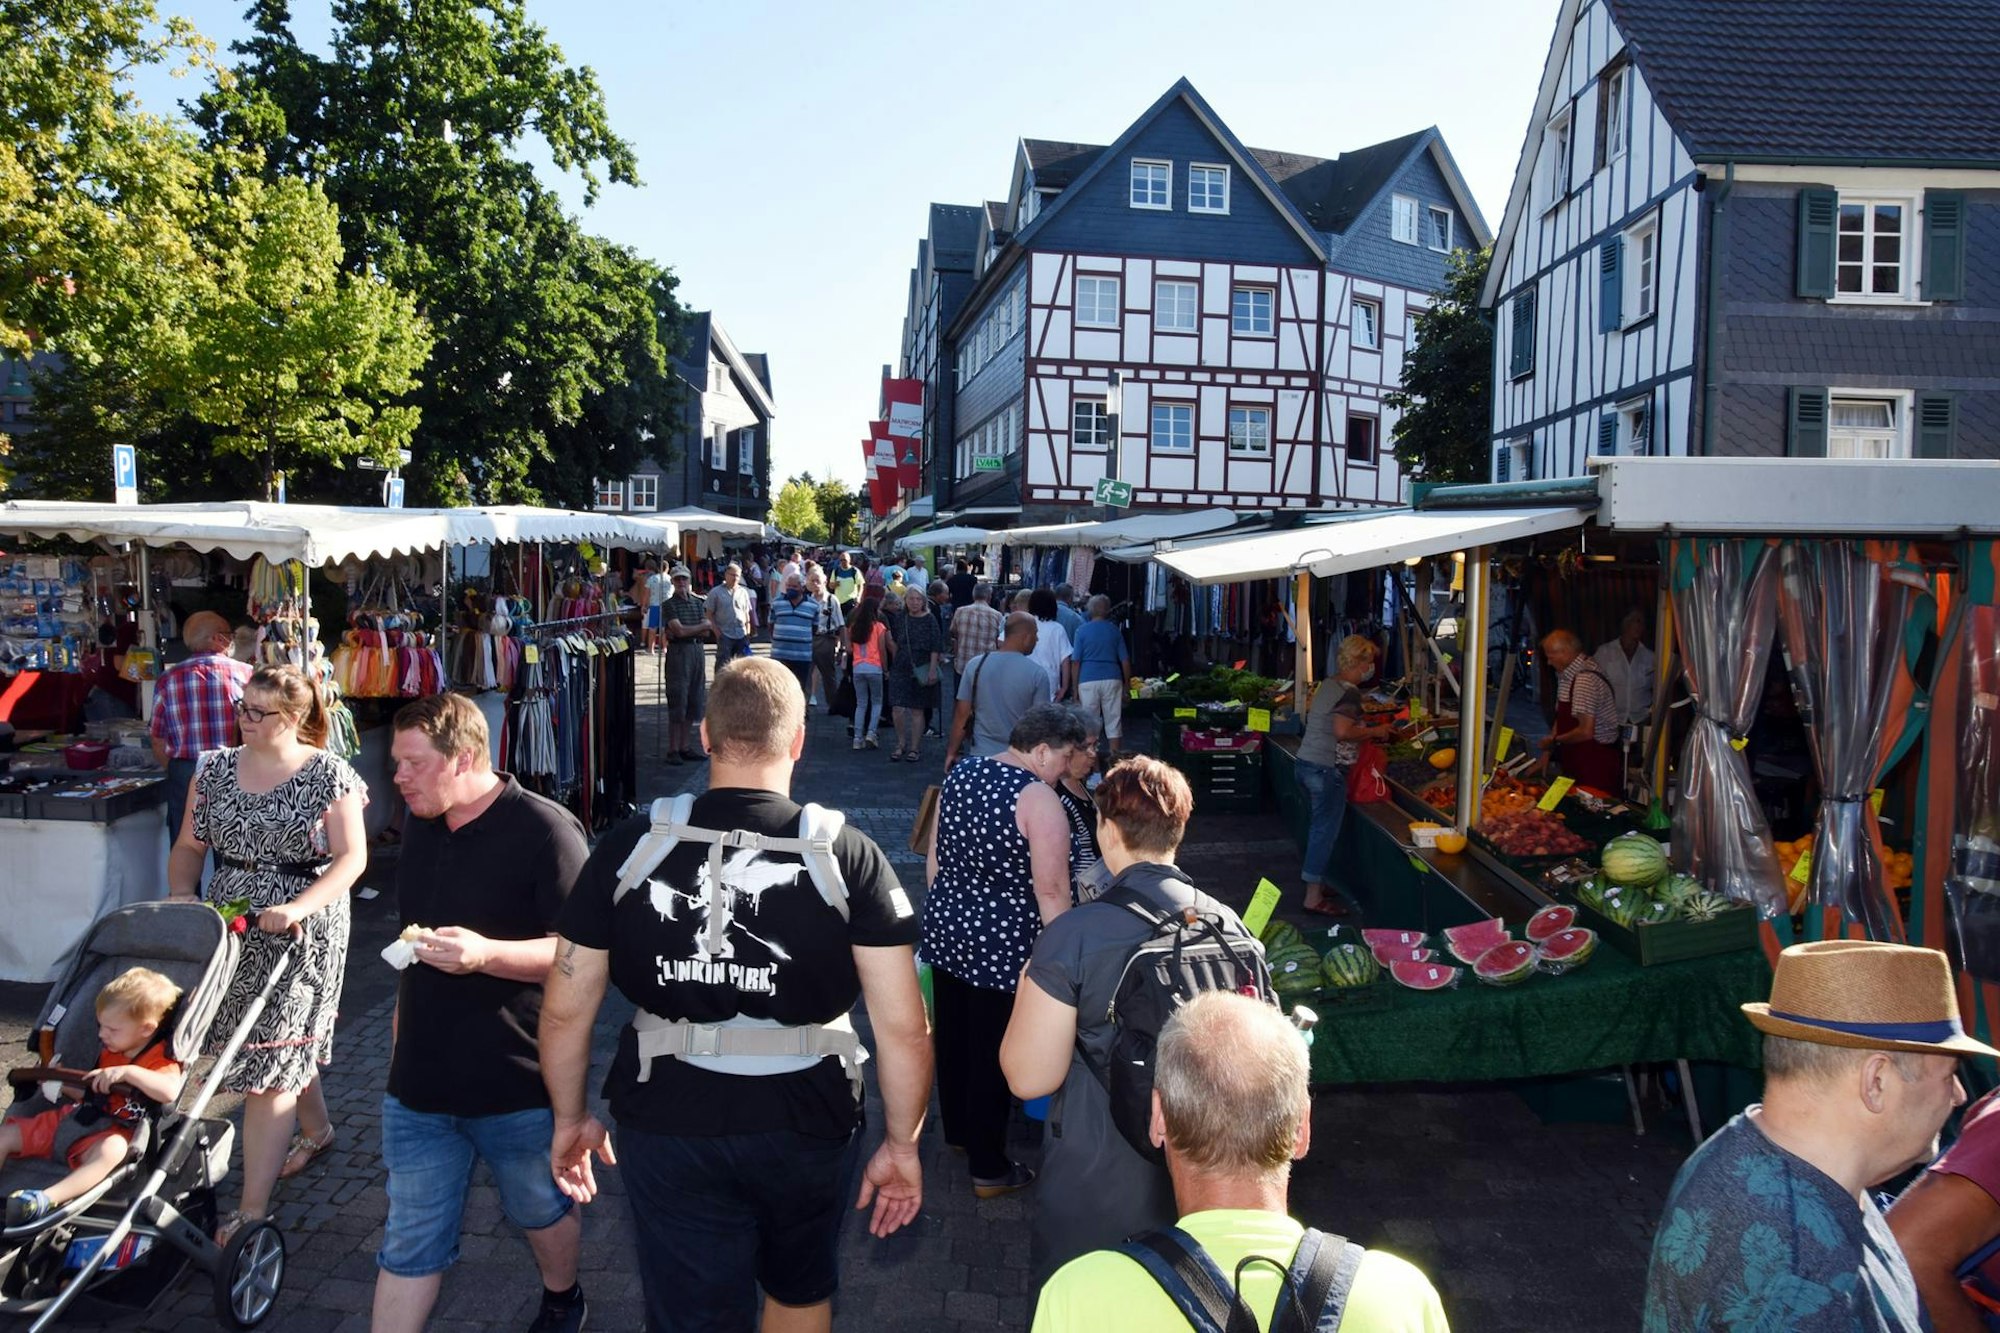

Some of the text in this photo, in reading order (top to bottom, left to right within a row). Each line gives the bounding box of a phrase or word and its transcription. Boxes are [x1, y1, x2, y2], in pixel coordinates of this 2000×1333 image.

[118, 450, 131, 484] P
[662, 959, 772, 990] LINKIN PARK
